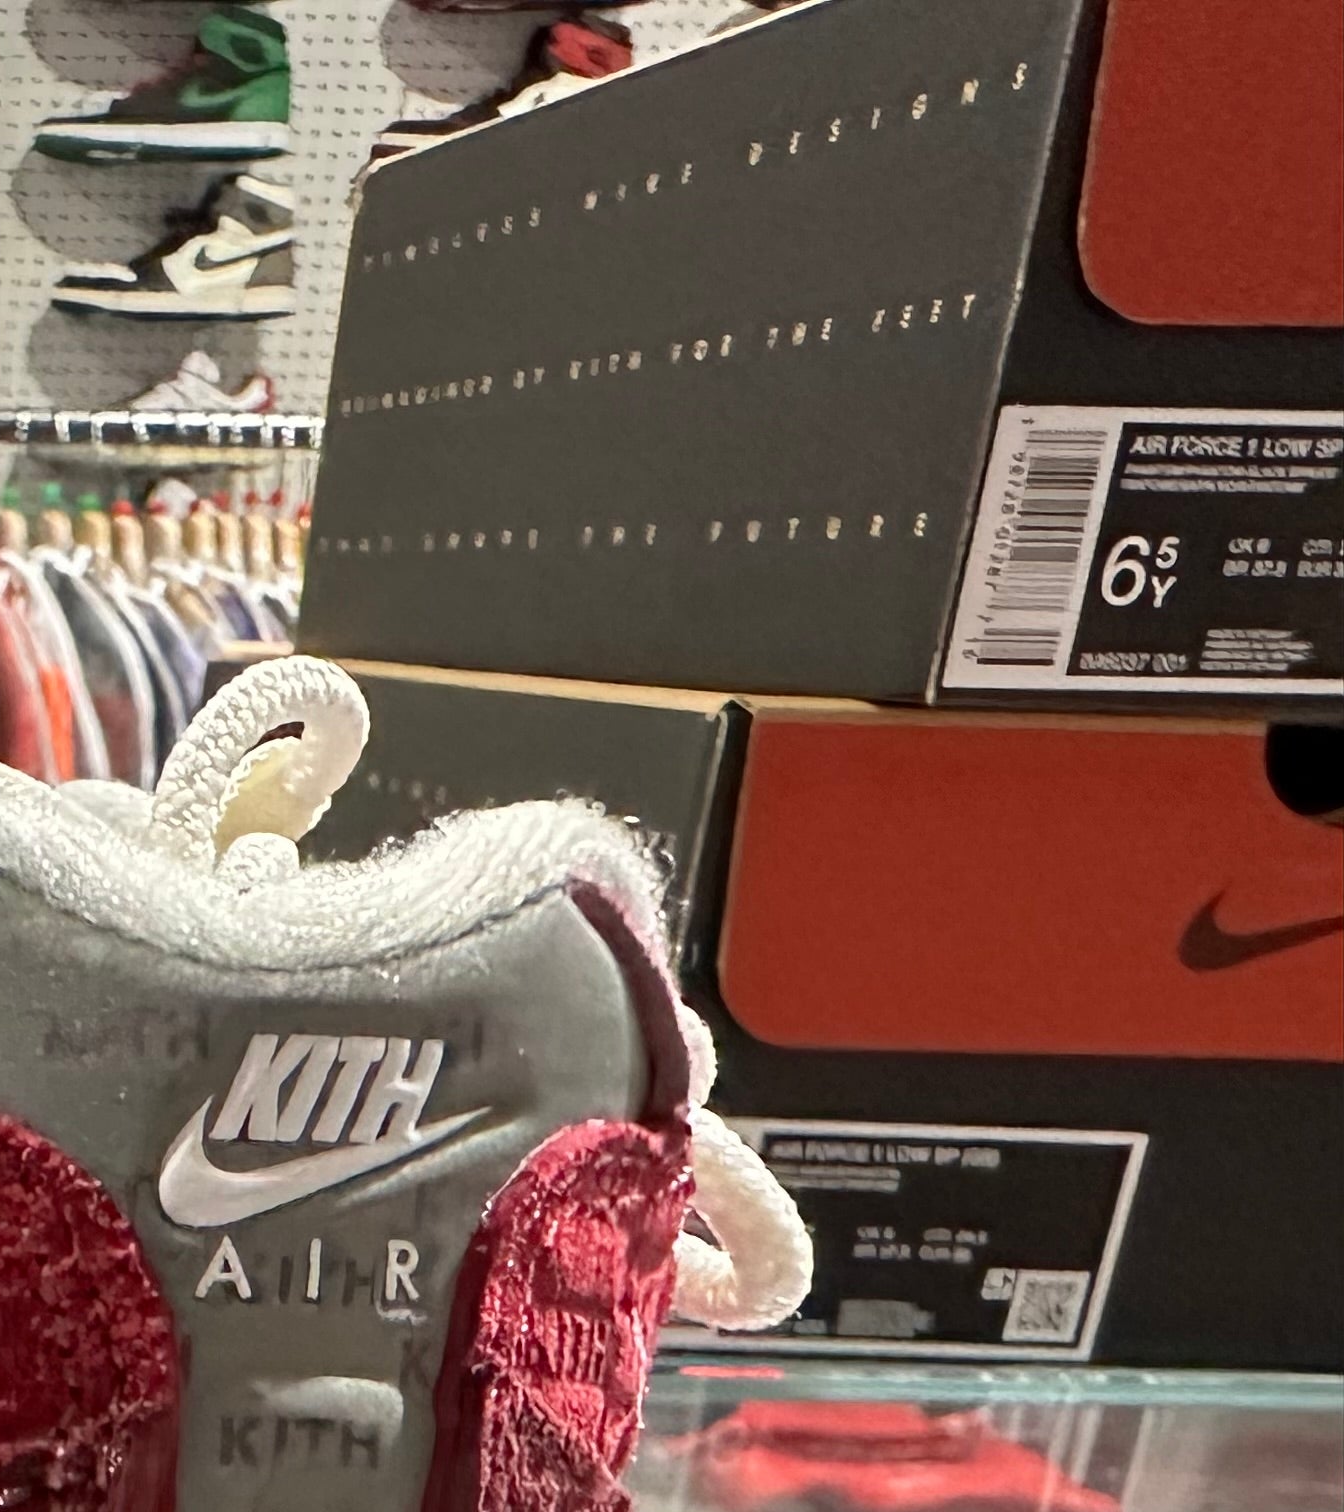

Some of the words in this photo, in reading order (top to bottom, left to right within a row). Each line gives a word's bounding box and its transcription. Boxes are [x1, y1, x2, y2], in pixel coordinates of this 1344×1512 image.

[1100, 534, 1151, 607] 6
[1150, 575, 1178, 609] Y
[208, 1033, 444, 1144] KITH
[194, 1235, 420, 1301] AIR
[218, 1415, 381, 1470] KITH
